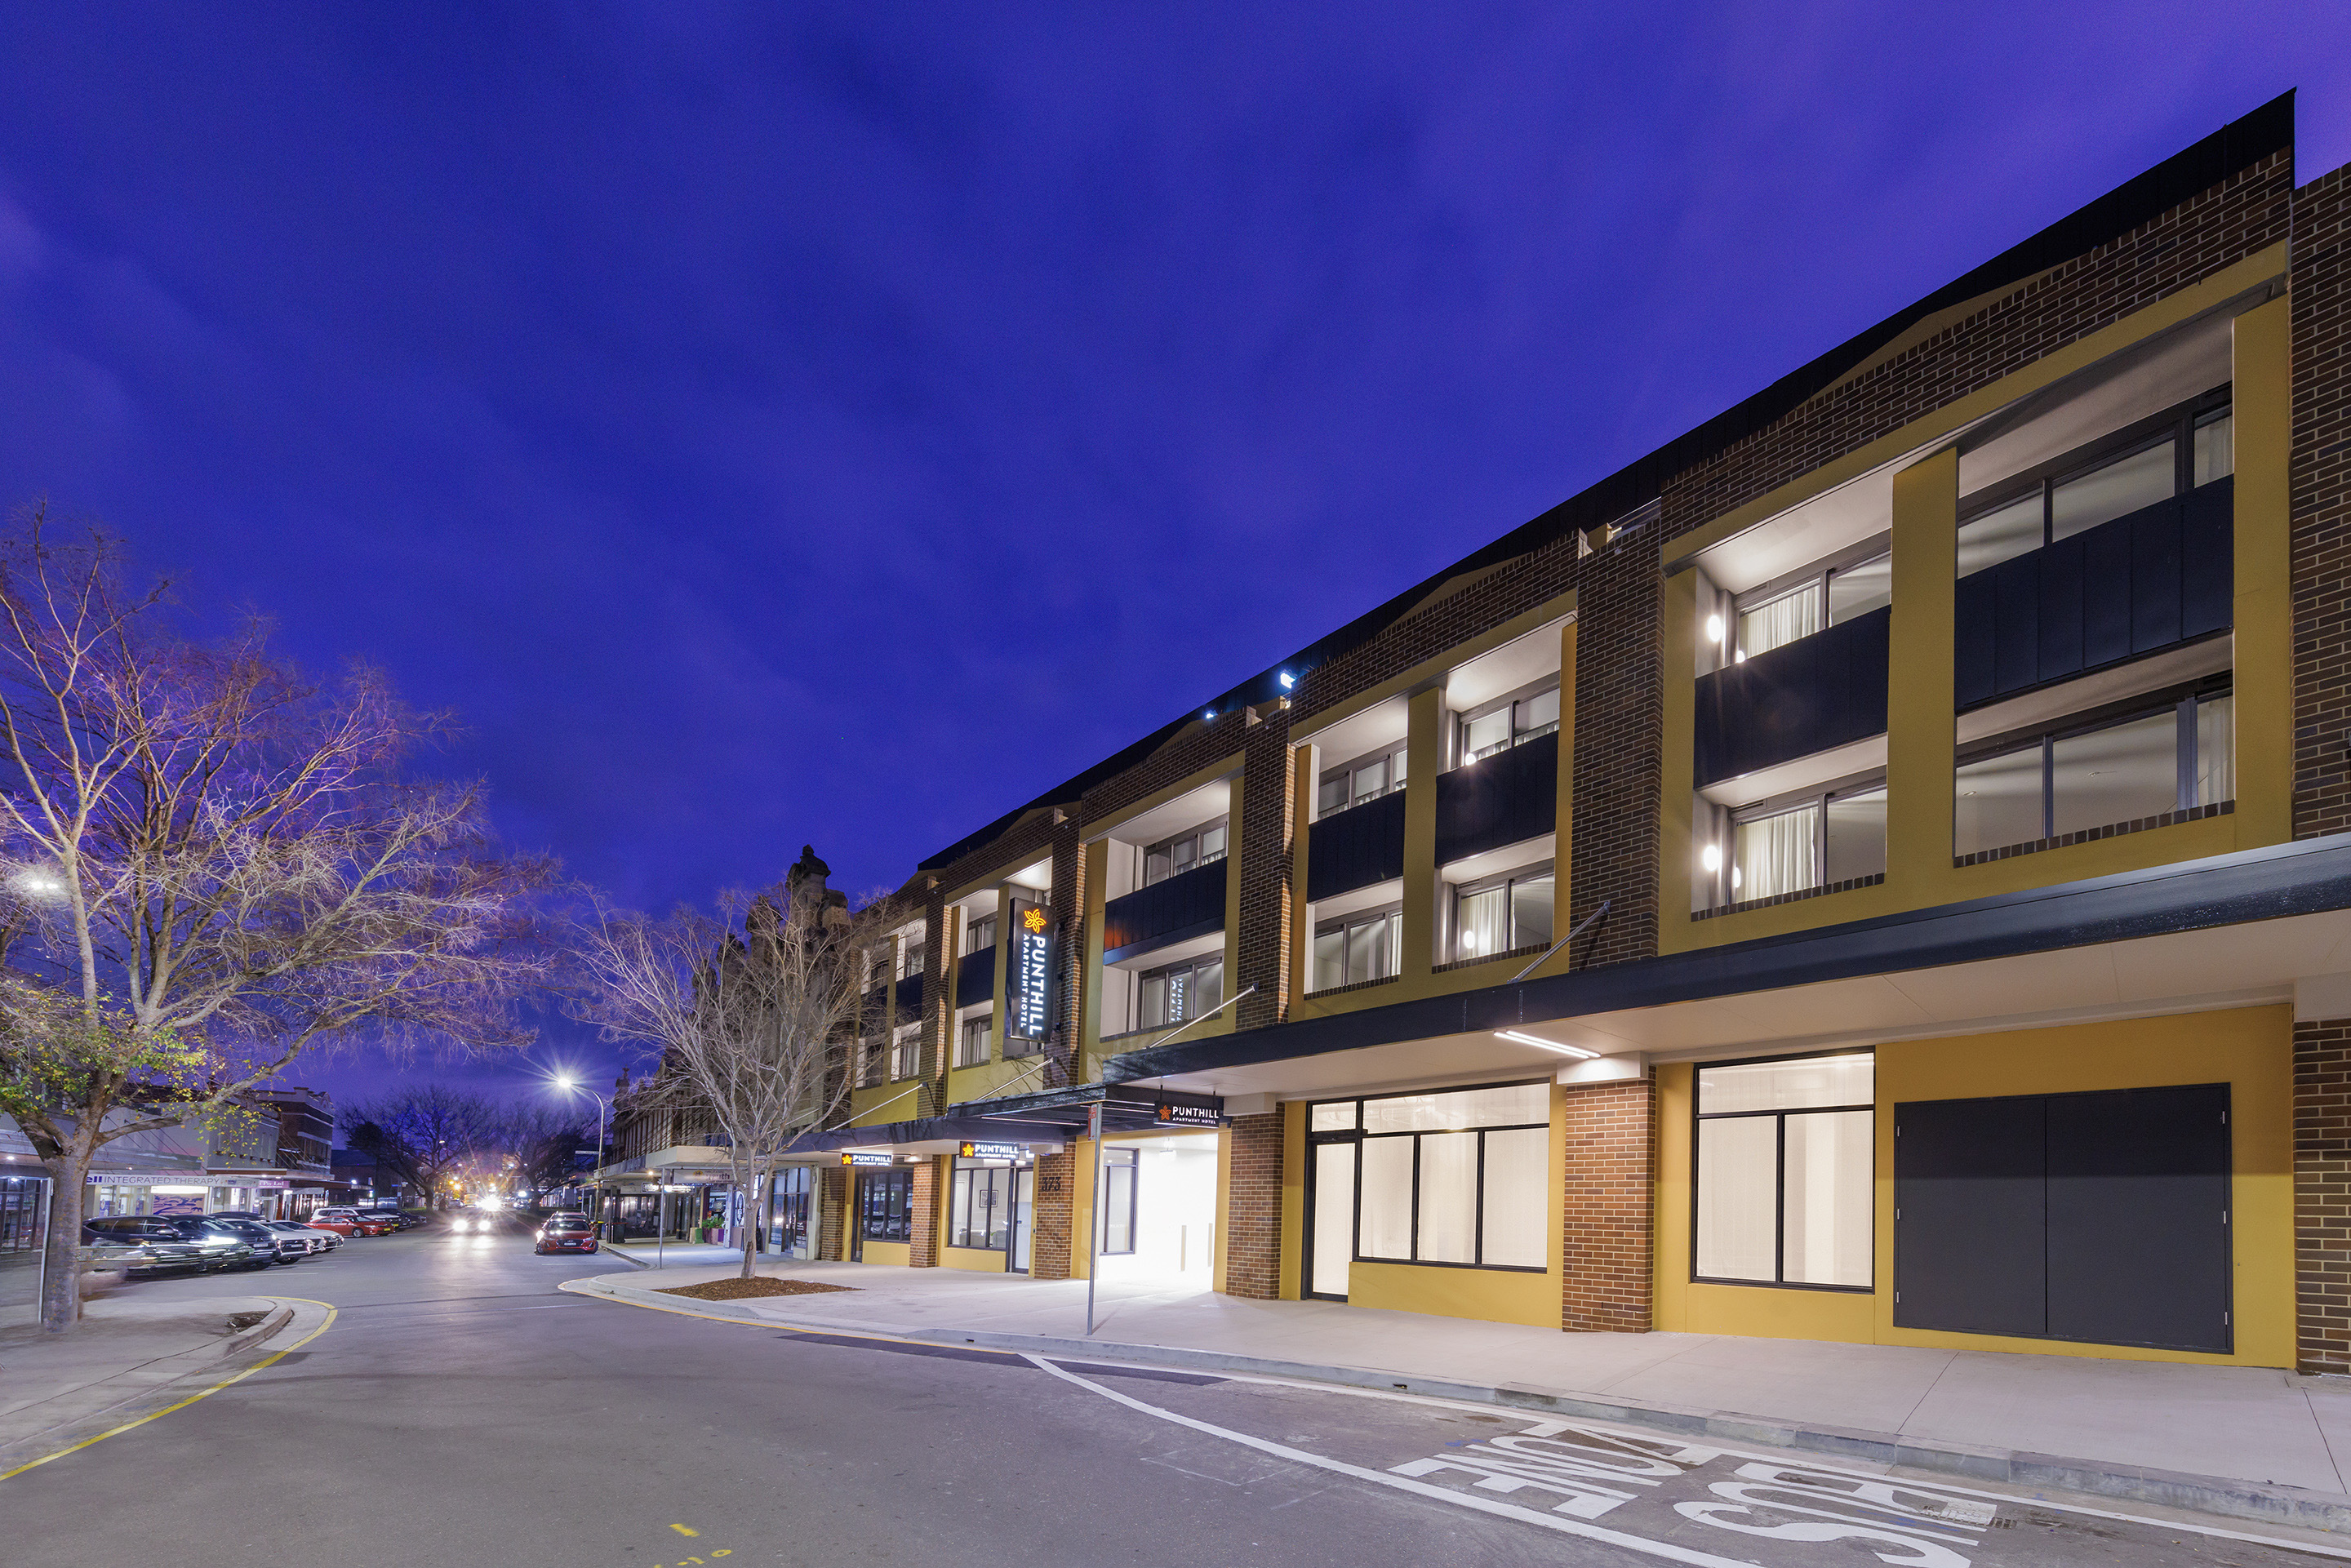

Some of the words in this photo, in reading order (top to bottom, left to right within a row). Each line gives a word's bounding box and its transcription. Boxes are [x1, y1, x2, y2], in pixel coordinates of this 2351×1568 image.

[1029, 935, 1046, 1035] PUNTHILL
[1172, 1106, 1219, 1119] PUNTHILL
[975, 1144, 1019, 1154] PUNTHILL
[104, 1175, 171, 1184] INTEGRATED
[174, 1176, 220, 1184] THERAPY
[1042, 1176, 1061, 1191] 373
[1388, 1422, 1722, 1519] ZONE
[1673, 1462, 1998, 1568] BUS
